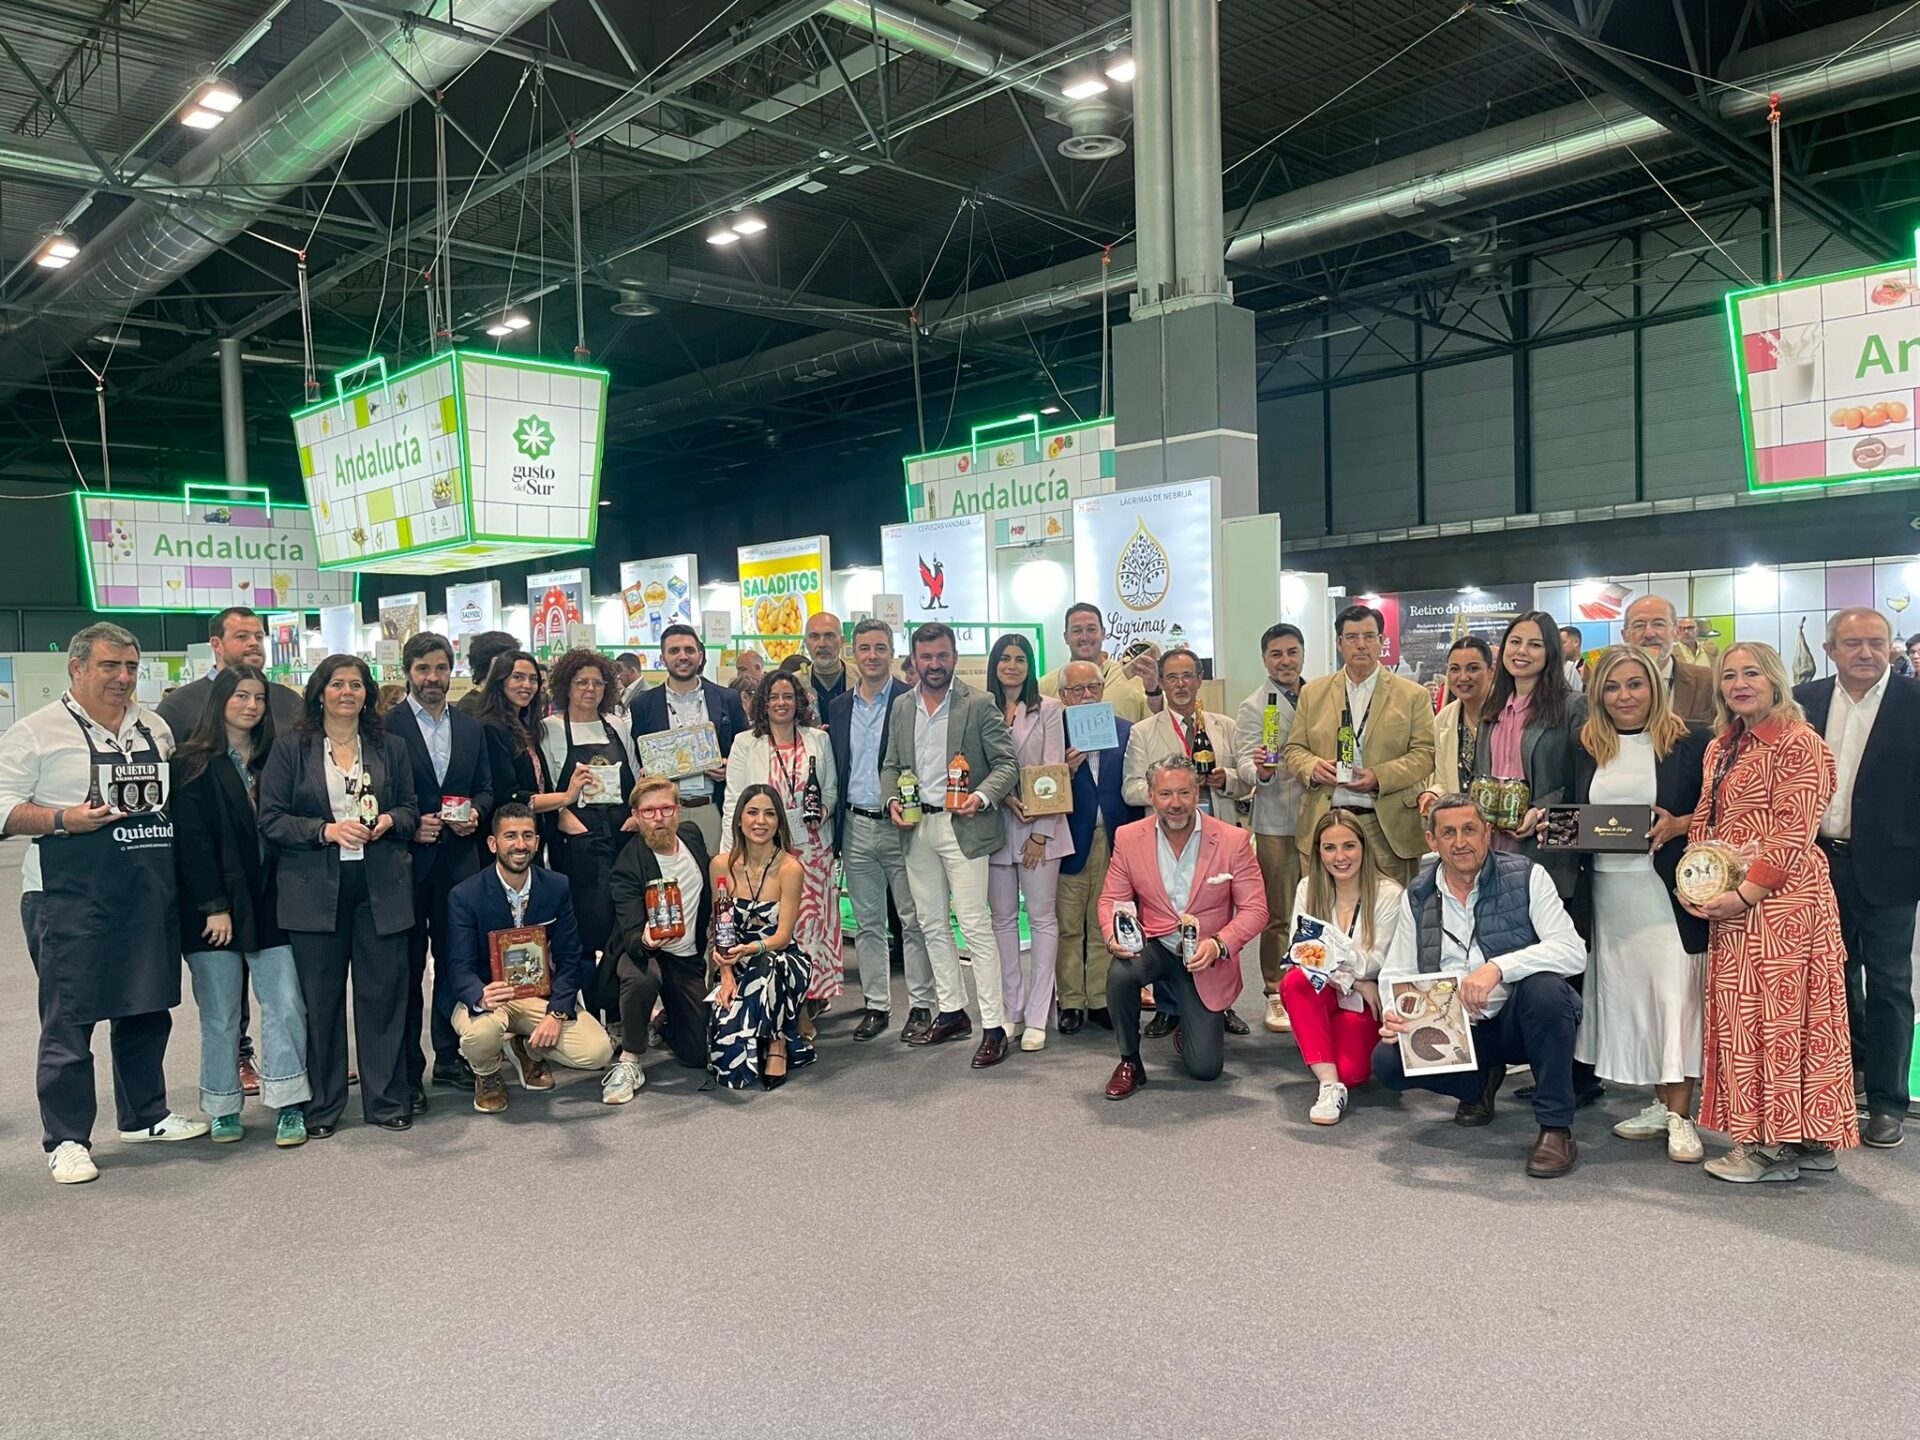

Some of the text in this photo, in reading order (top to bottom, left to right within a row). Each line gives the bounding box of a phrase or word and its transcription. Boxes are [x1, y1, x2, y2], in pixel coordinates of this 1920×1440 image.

[335, 424, 422, 487] Andalucía
[512, 465, 555, 483] gusto
[514, 478, 555, 495] del Sur
[952, 468, 1069, 516] Andalucía
[1153, 493, 1163, 502] DE
[1163, 489, 1192, 501] NEBRIJA
[153, 533, 304, 561] Andalucía
[743, 571, 819, 598] SALADITOS
[1410, 601, 1517, 617] Retiro de bienestar
[1106, 612, 1166, 645] Lágrimas
[115, 765, 156, 777] QUIETUD
[112, 822, 174, 843] Quietud
